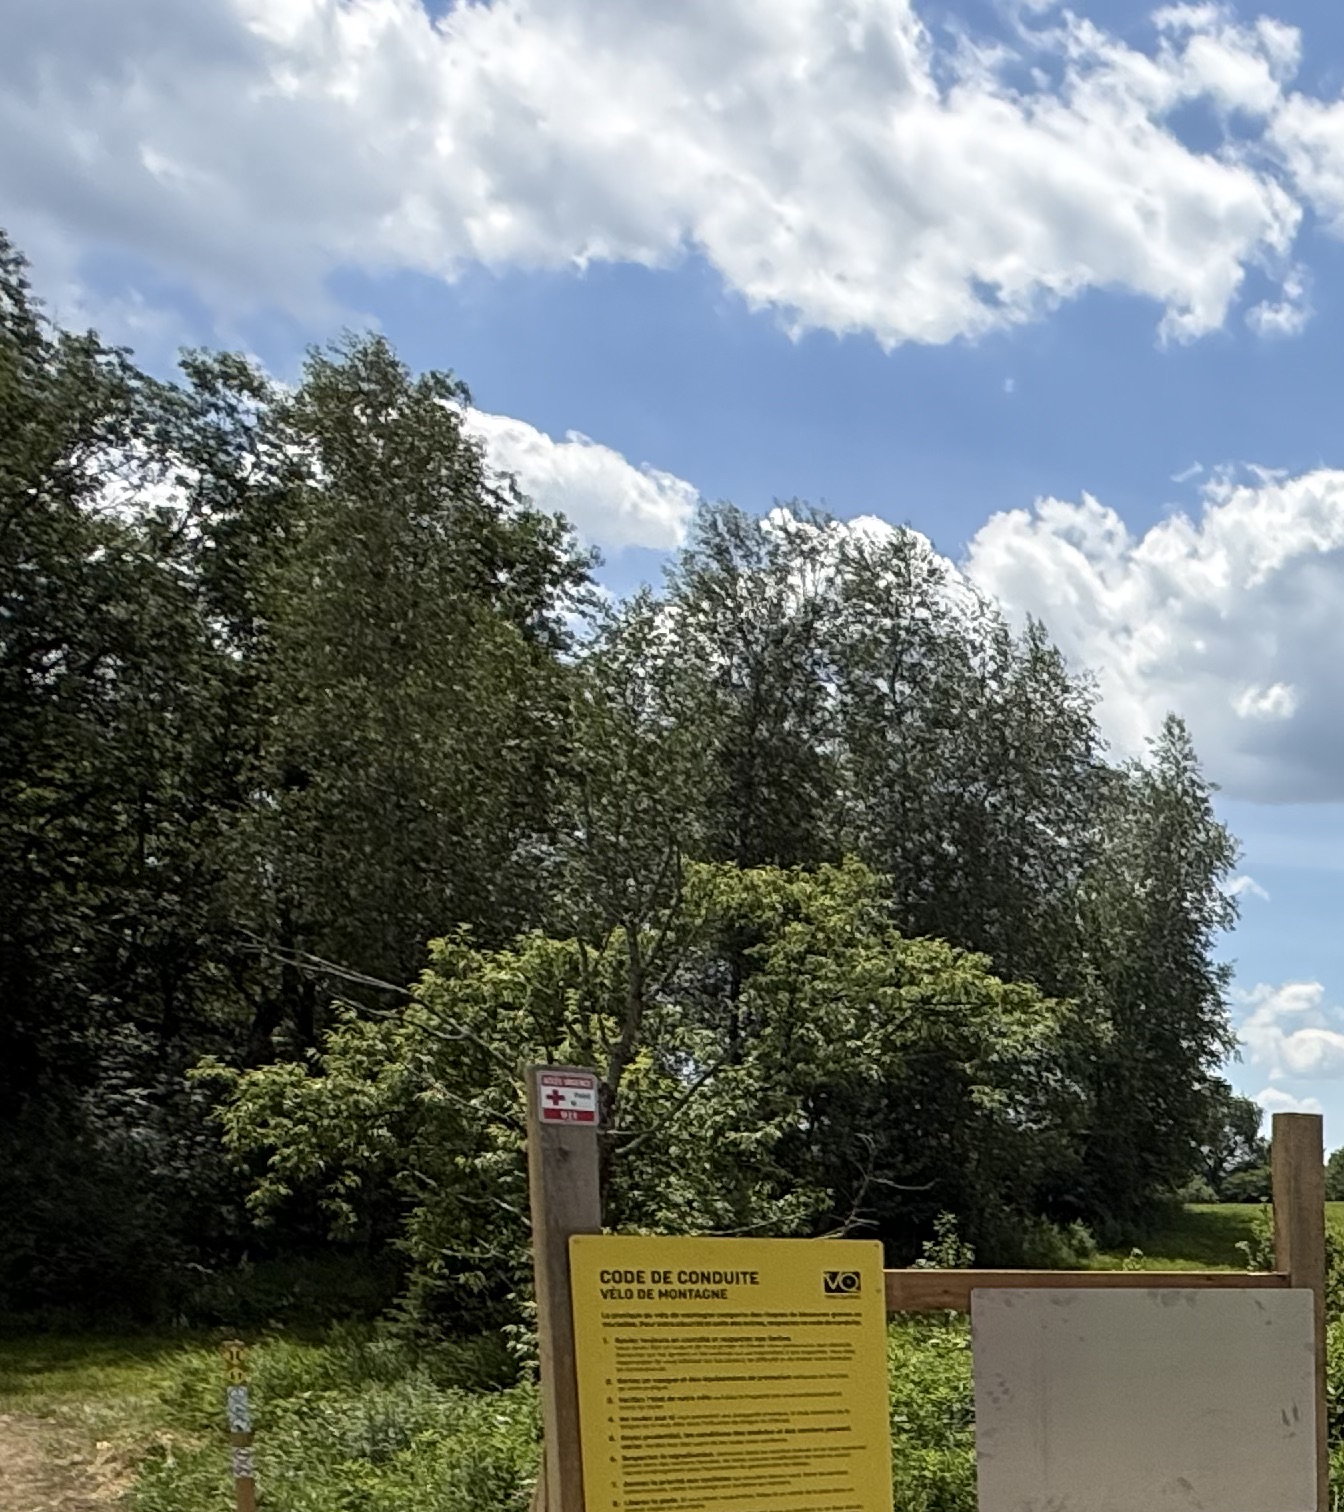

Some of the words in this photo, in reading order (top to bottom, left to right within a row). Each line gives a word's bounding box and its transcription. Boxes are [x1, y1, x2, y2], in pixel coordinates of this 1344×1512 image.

[599, 1269, 646, 1285] CODE
[650, 1270, 674, 1286] DE
[676, 1270, 760, 1286] CONDUITE
[600, 1286, 634, 1300] VÉLO
[637, 1288, 655, 1300] DE
[658, 1288, 728, 1301] MONTAGNE
